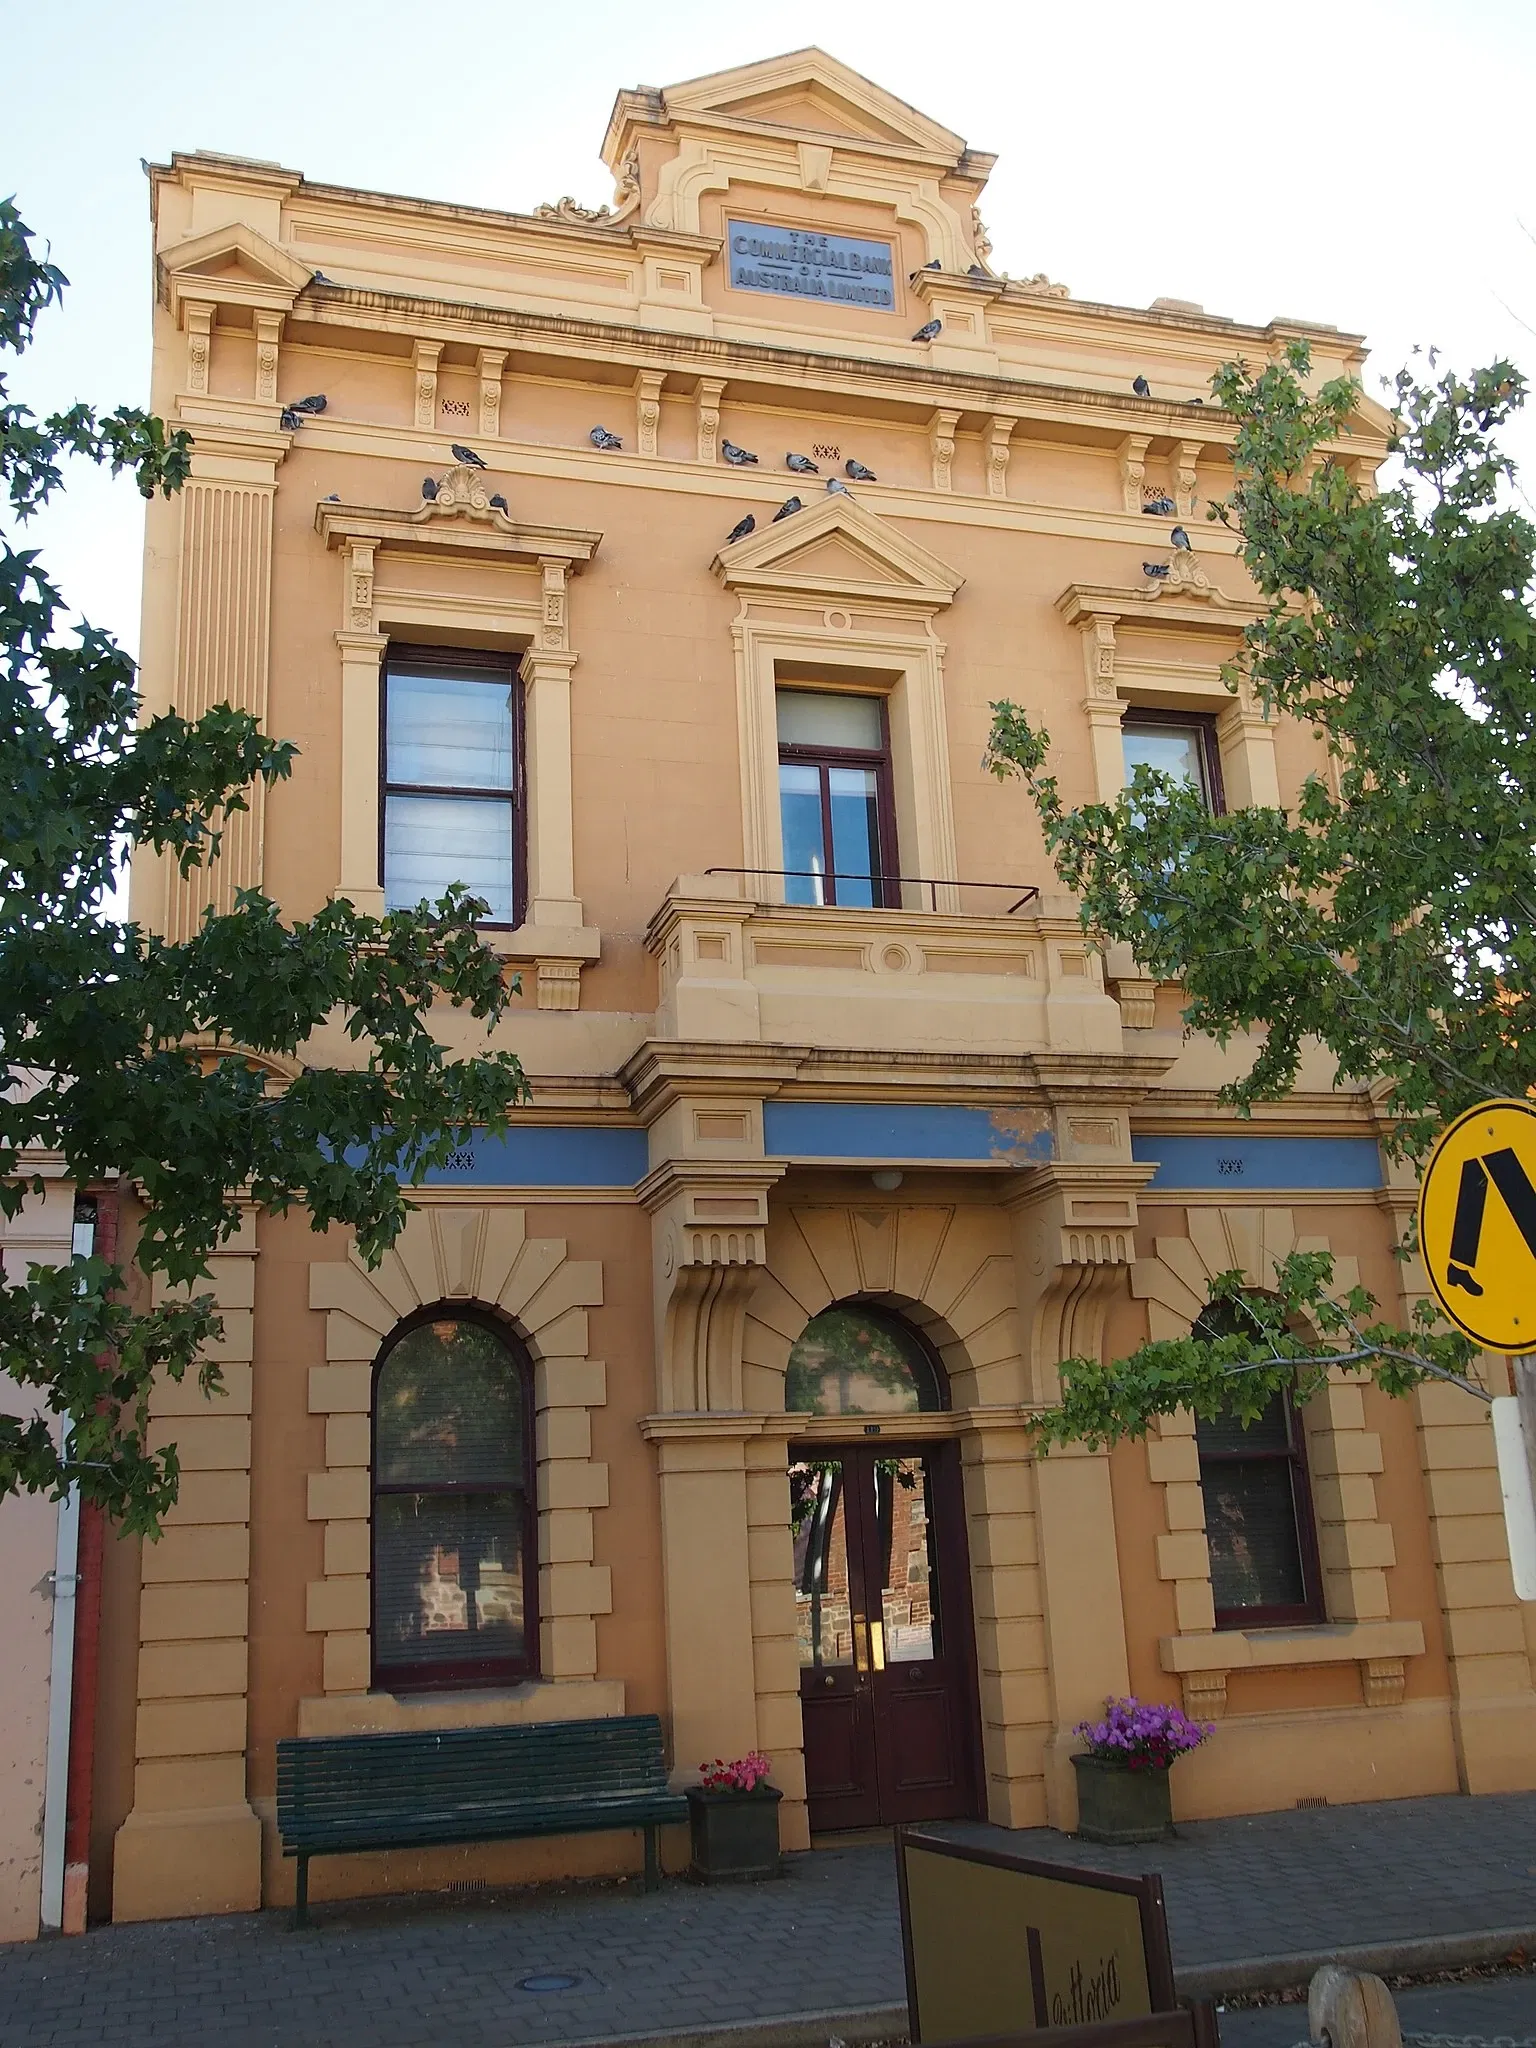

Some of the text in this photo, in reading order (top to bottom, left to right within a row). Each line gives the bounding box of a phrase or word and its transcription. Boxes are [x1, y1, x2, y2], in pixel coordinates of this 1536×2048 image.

[789, 232, 828, 248] THE
[733, 235, 892, 276] COMMERCIAL BANK
[799, 266, 822, 278] OF
[735, 267, 891, 305] AUSTRALIA LIMITED
